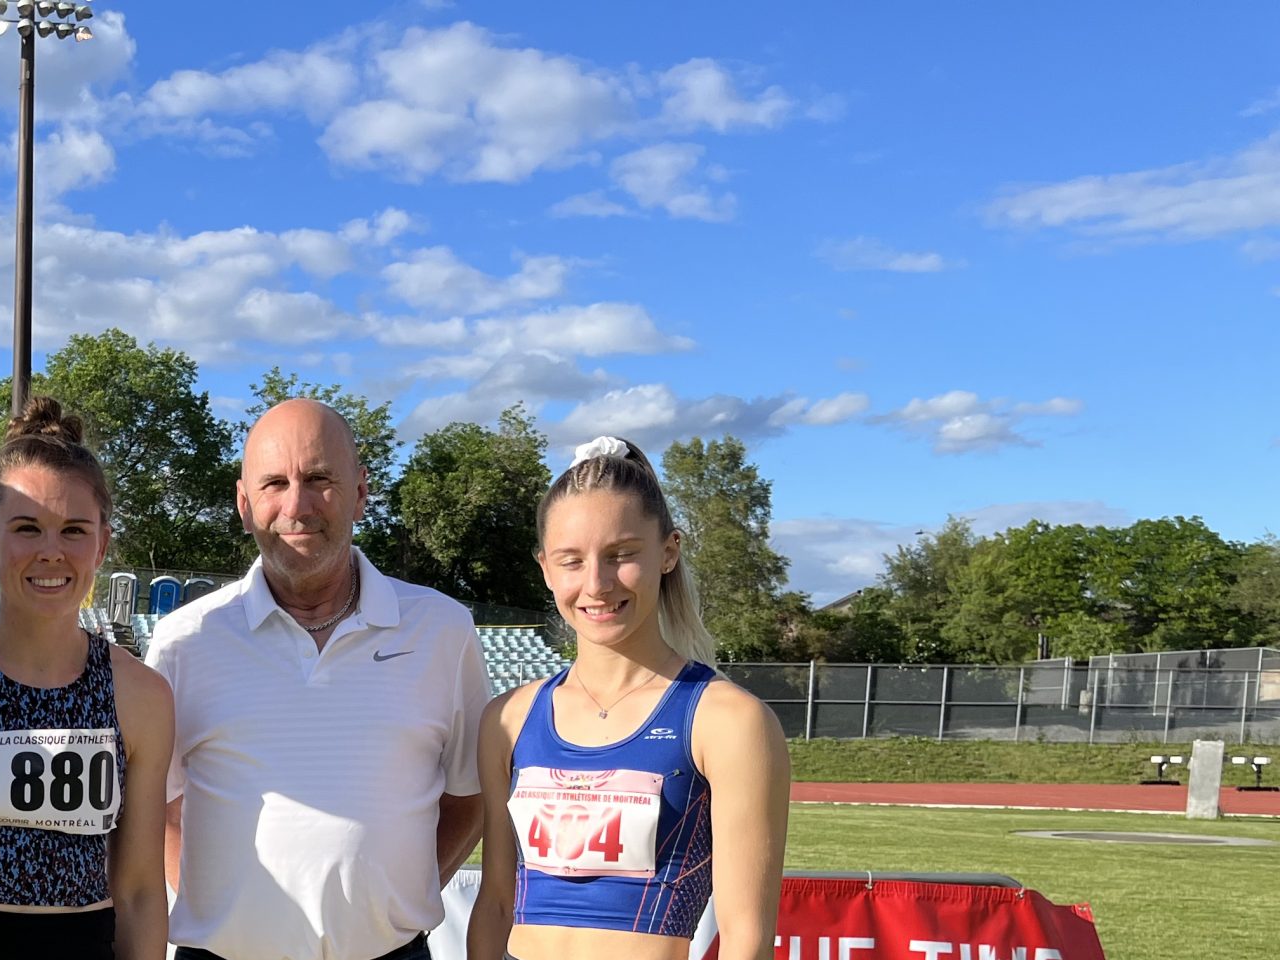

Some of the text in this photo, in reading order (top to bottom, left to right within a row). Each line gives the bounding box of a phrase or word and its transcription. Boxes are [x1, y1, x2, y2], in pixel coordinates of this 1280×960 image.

[0, 737, 11, 746] LA
[12, 735, 66, 746] CLASSIQUE
[10, 751, 114, 811] 880
[602, 794, 611, 803] DE
[613, 794, 651, 806] MONTRÉAL
[35, 818, 96, 828] MONTRÉAL
